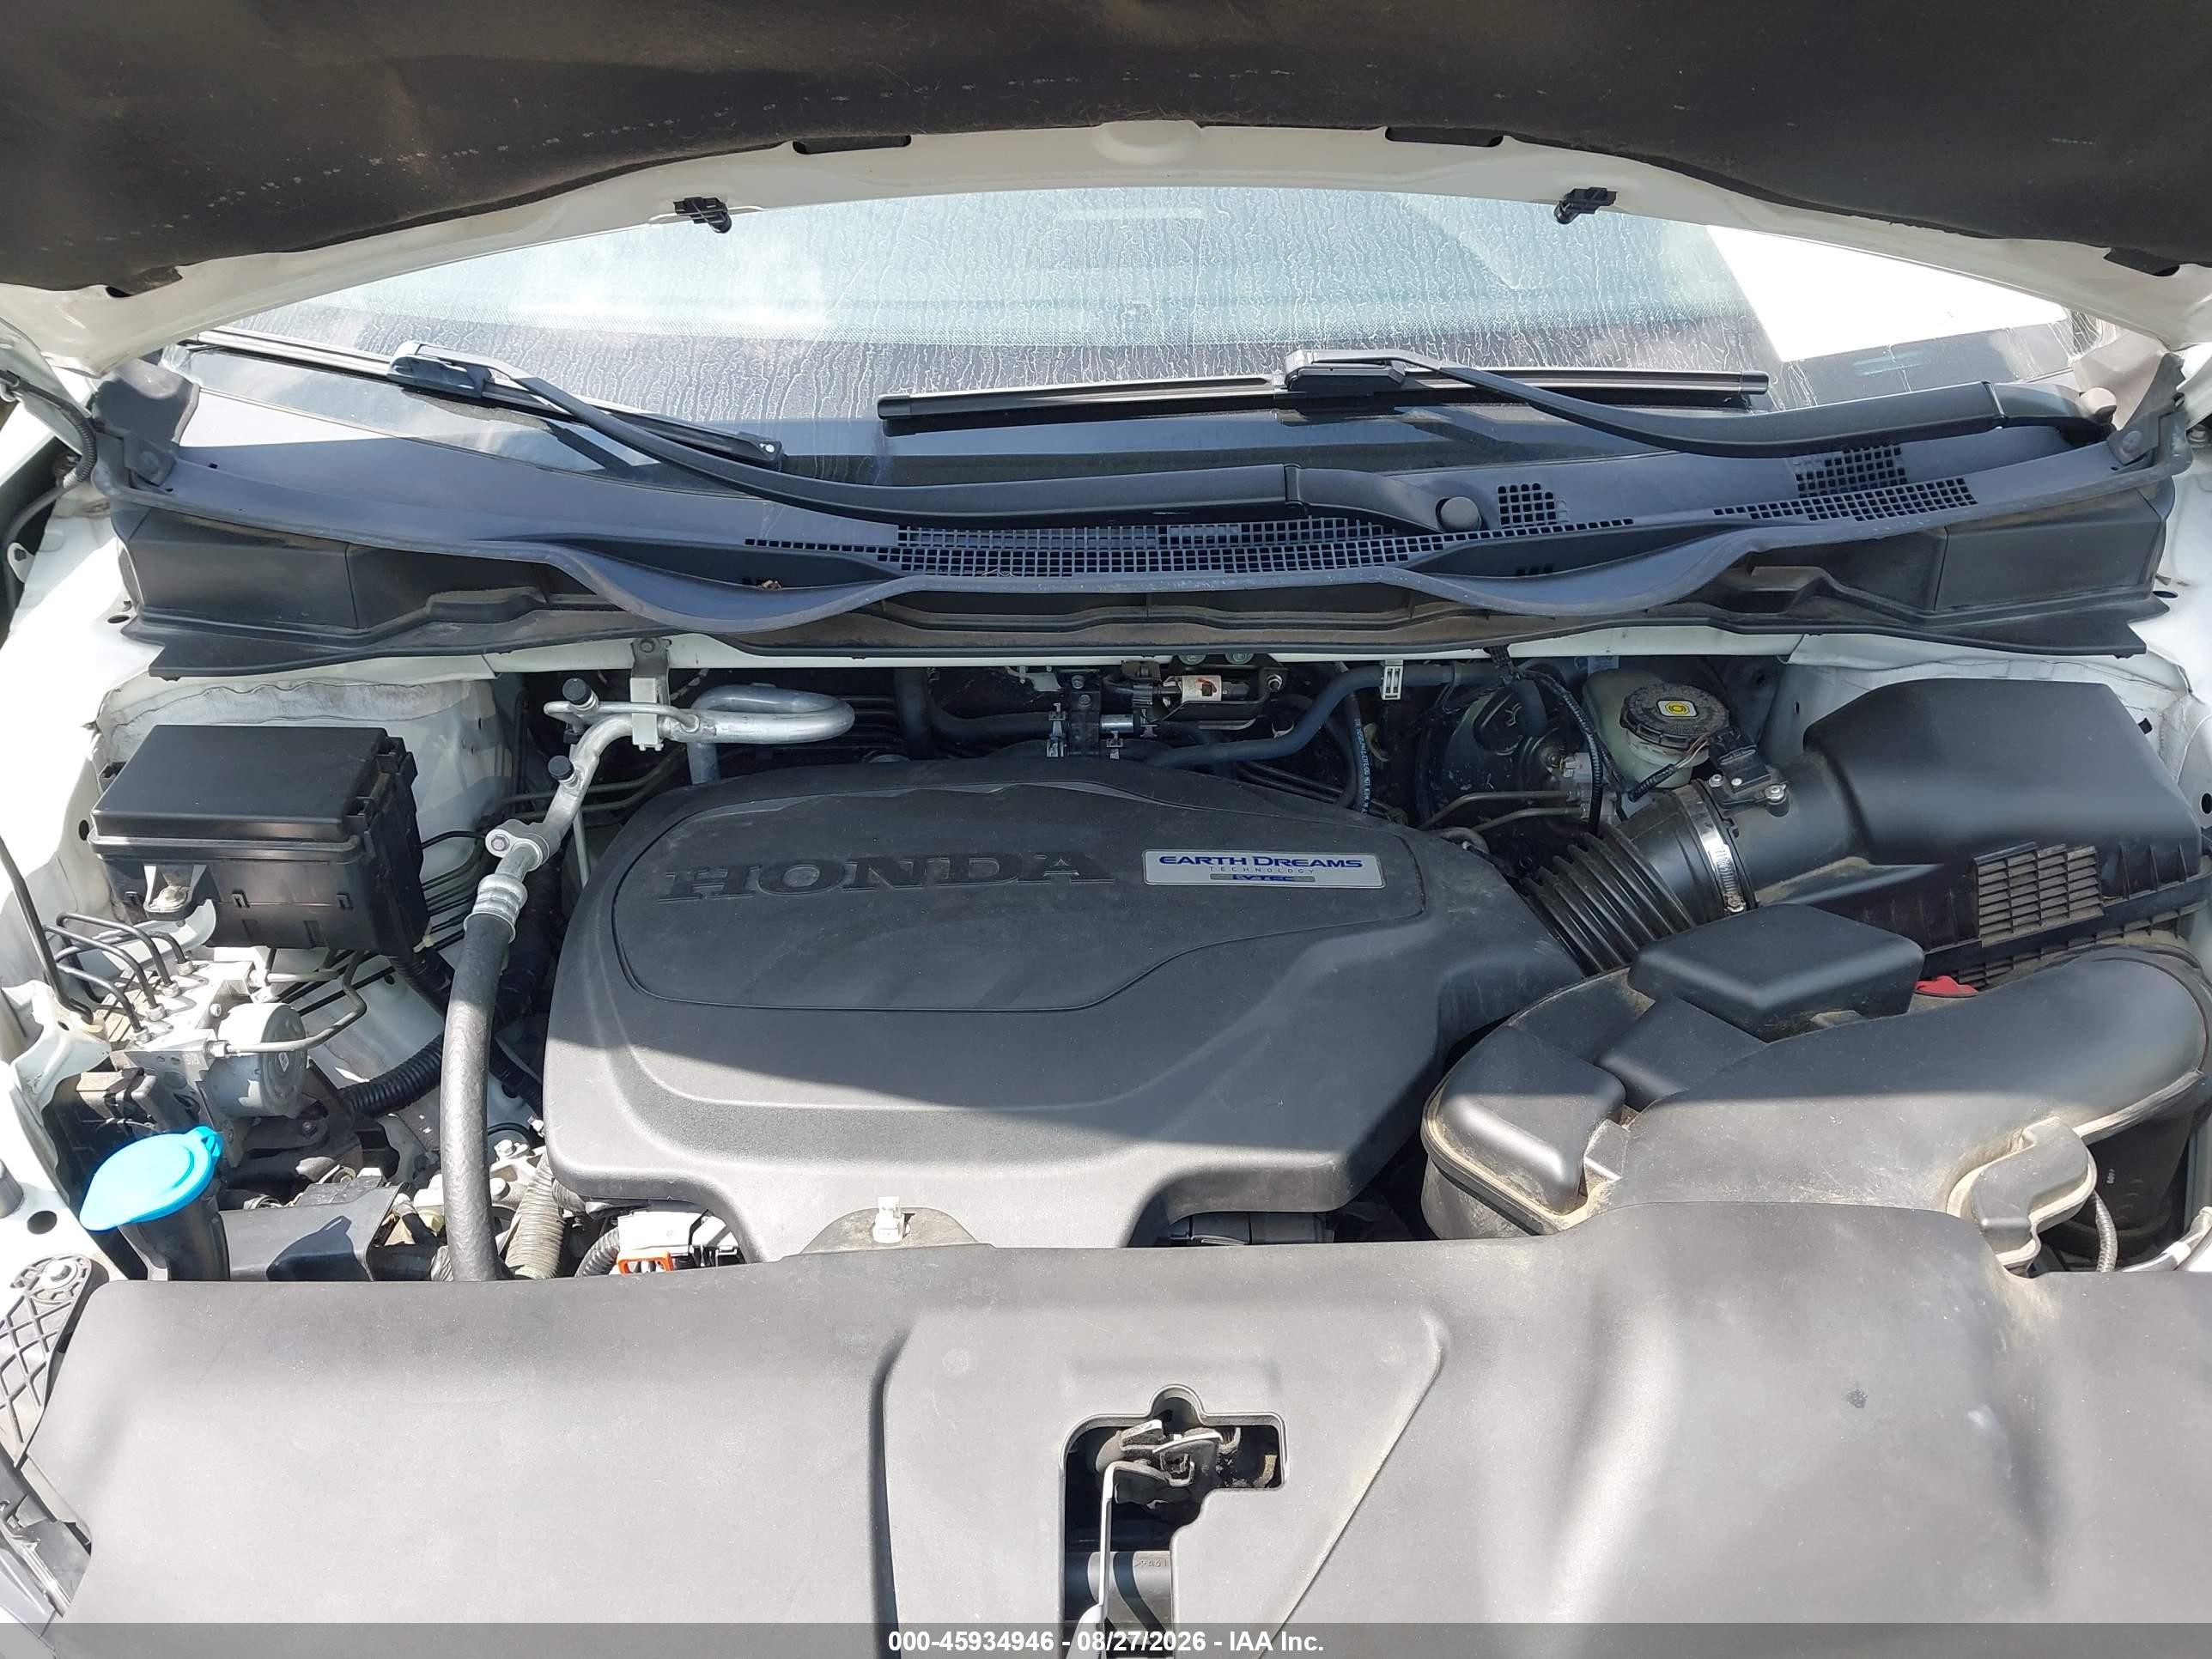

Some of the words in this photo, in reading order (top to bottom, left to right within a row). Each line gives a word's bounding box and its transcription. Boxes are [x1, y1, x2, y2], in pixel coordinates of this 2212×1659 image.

[657, 852, 1115, 902] HONDA
[1158, 855, 1247, 866] EARTH
[1252, 856, 1363, 868] DREAMS
